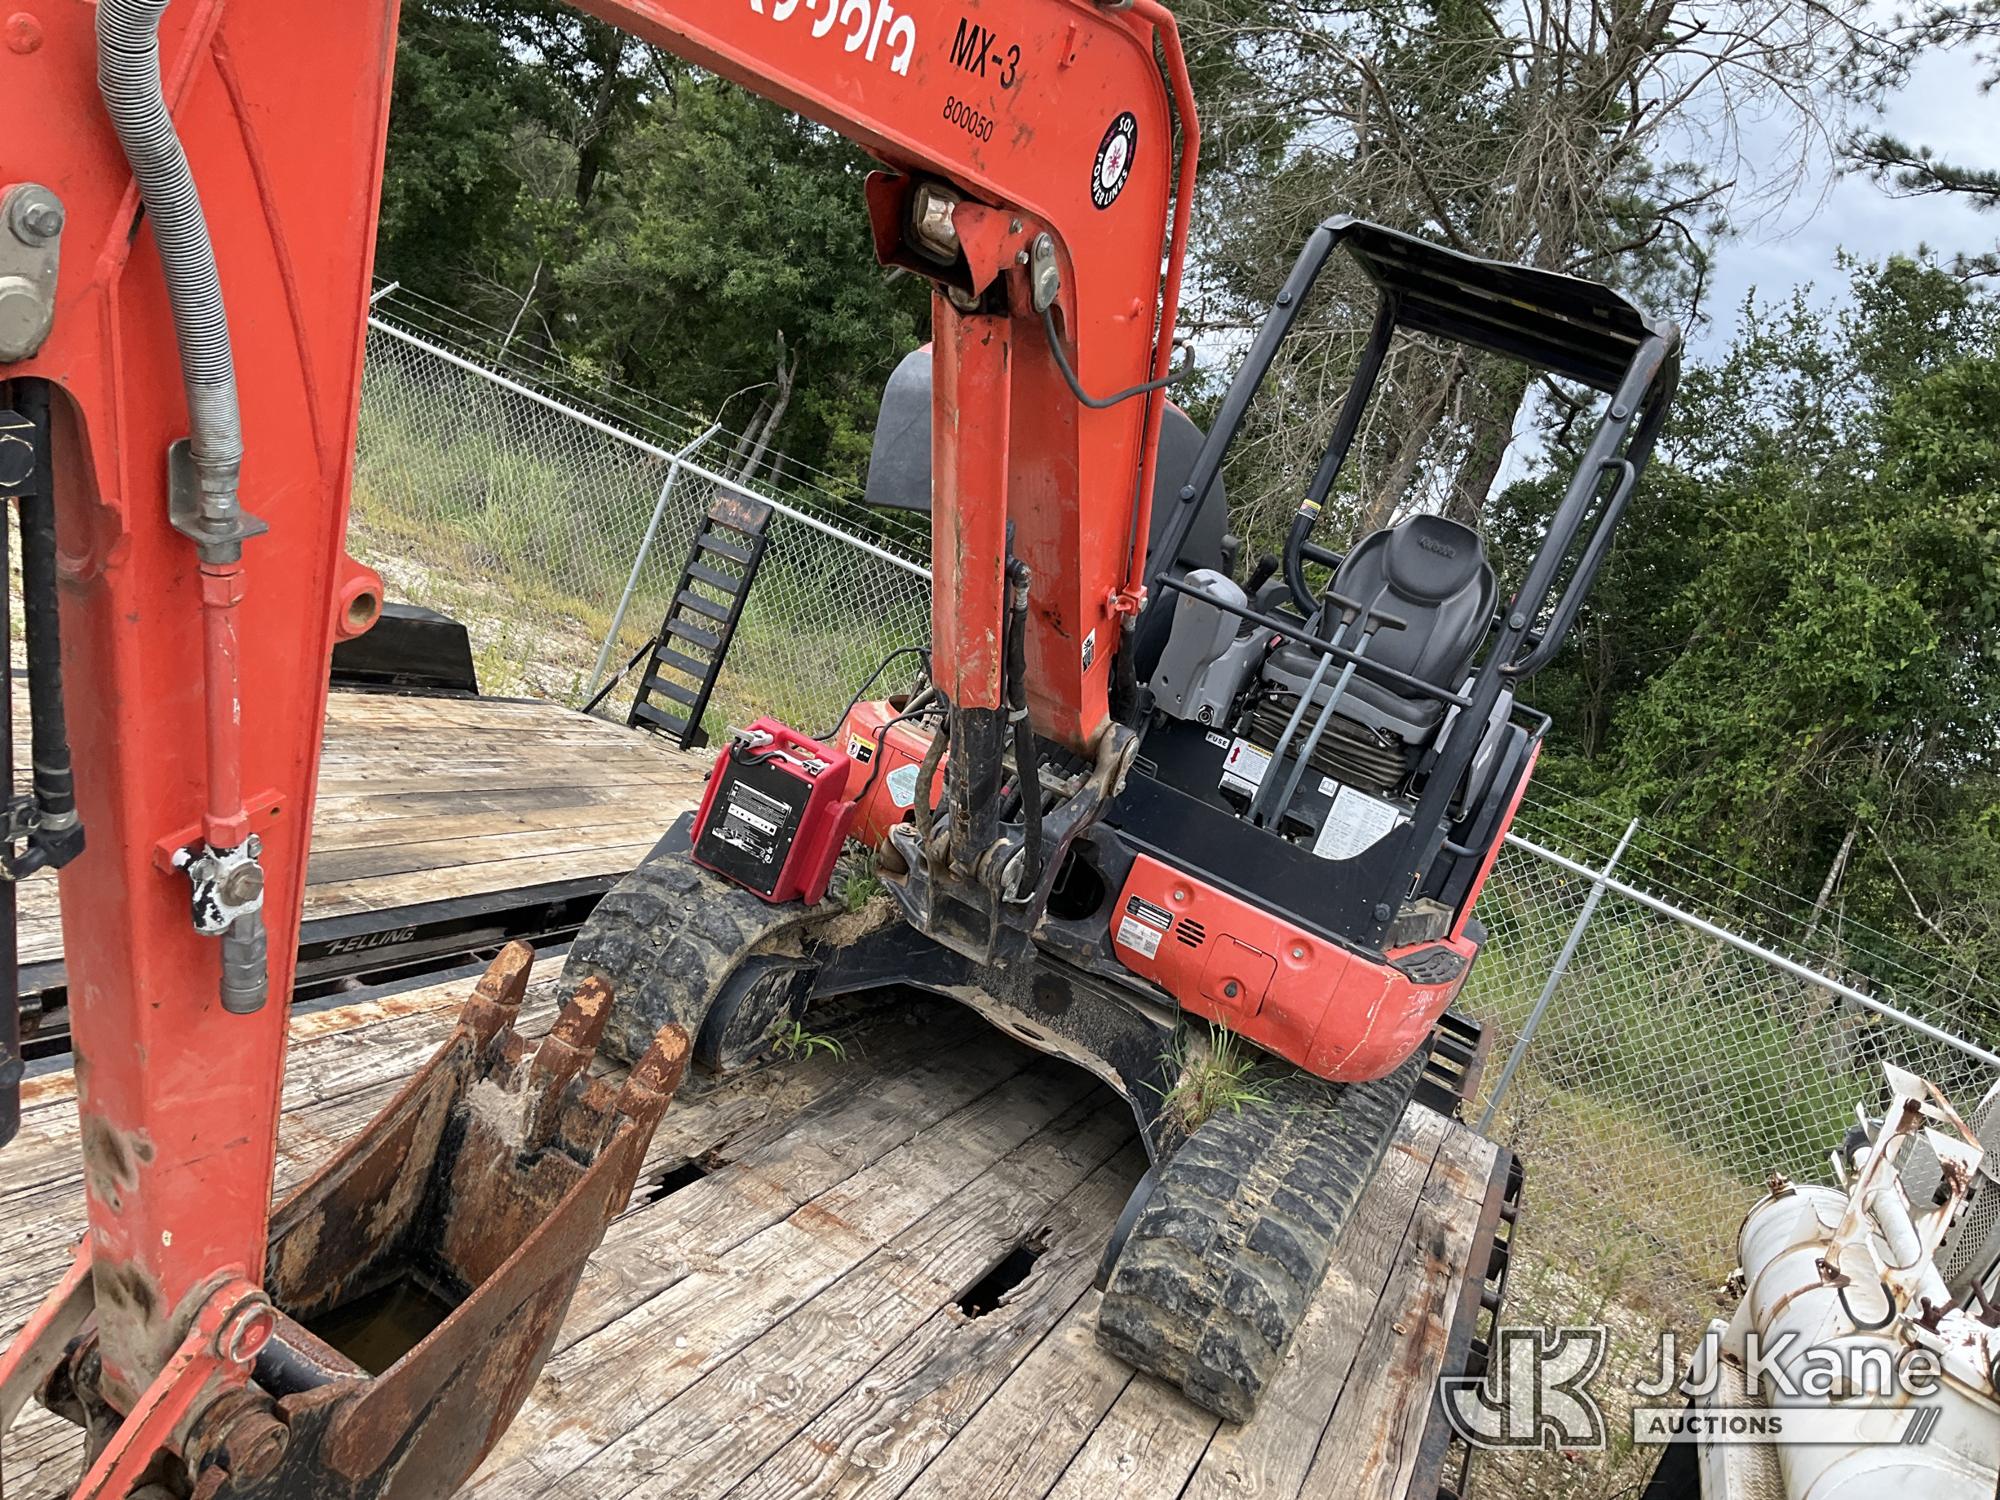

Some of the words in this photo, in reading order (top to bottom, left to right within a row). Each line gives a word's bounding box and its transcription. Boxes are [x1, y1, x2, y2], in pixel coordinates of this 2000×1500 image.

[749, 0, 916, 77] ota
[949, 16, 1021, 89] MX-3
[943, 95, 993, 142] 800050
[1118, 116, 1134, 139] SOL
[1093, 153, 1128, 205] POWERLINES
[1207, 733, 1228, 747] FUSE
